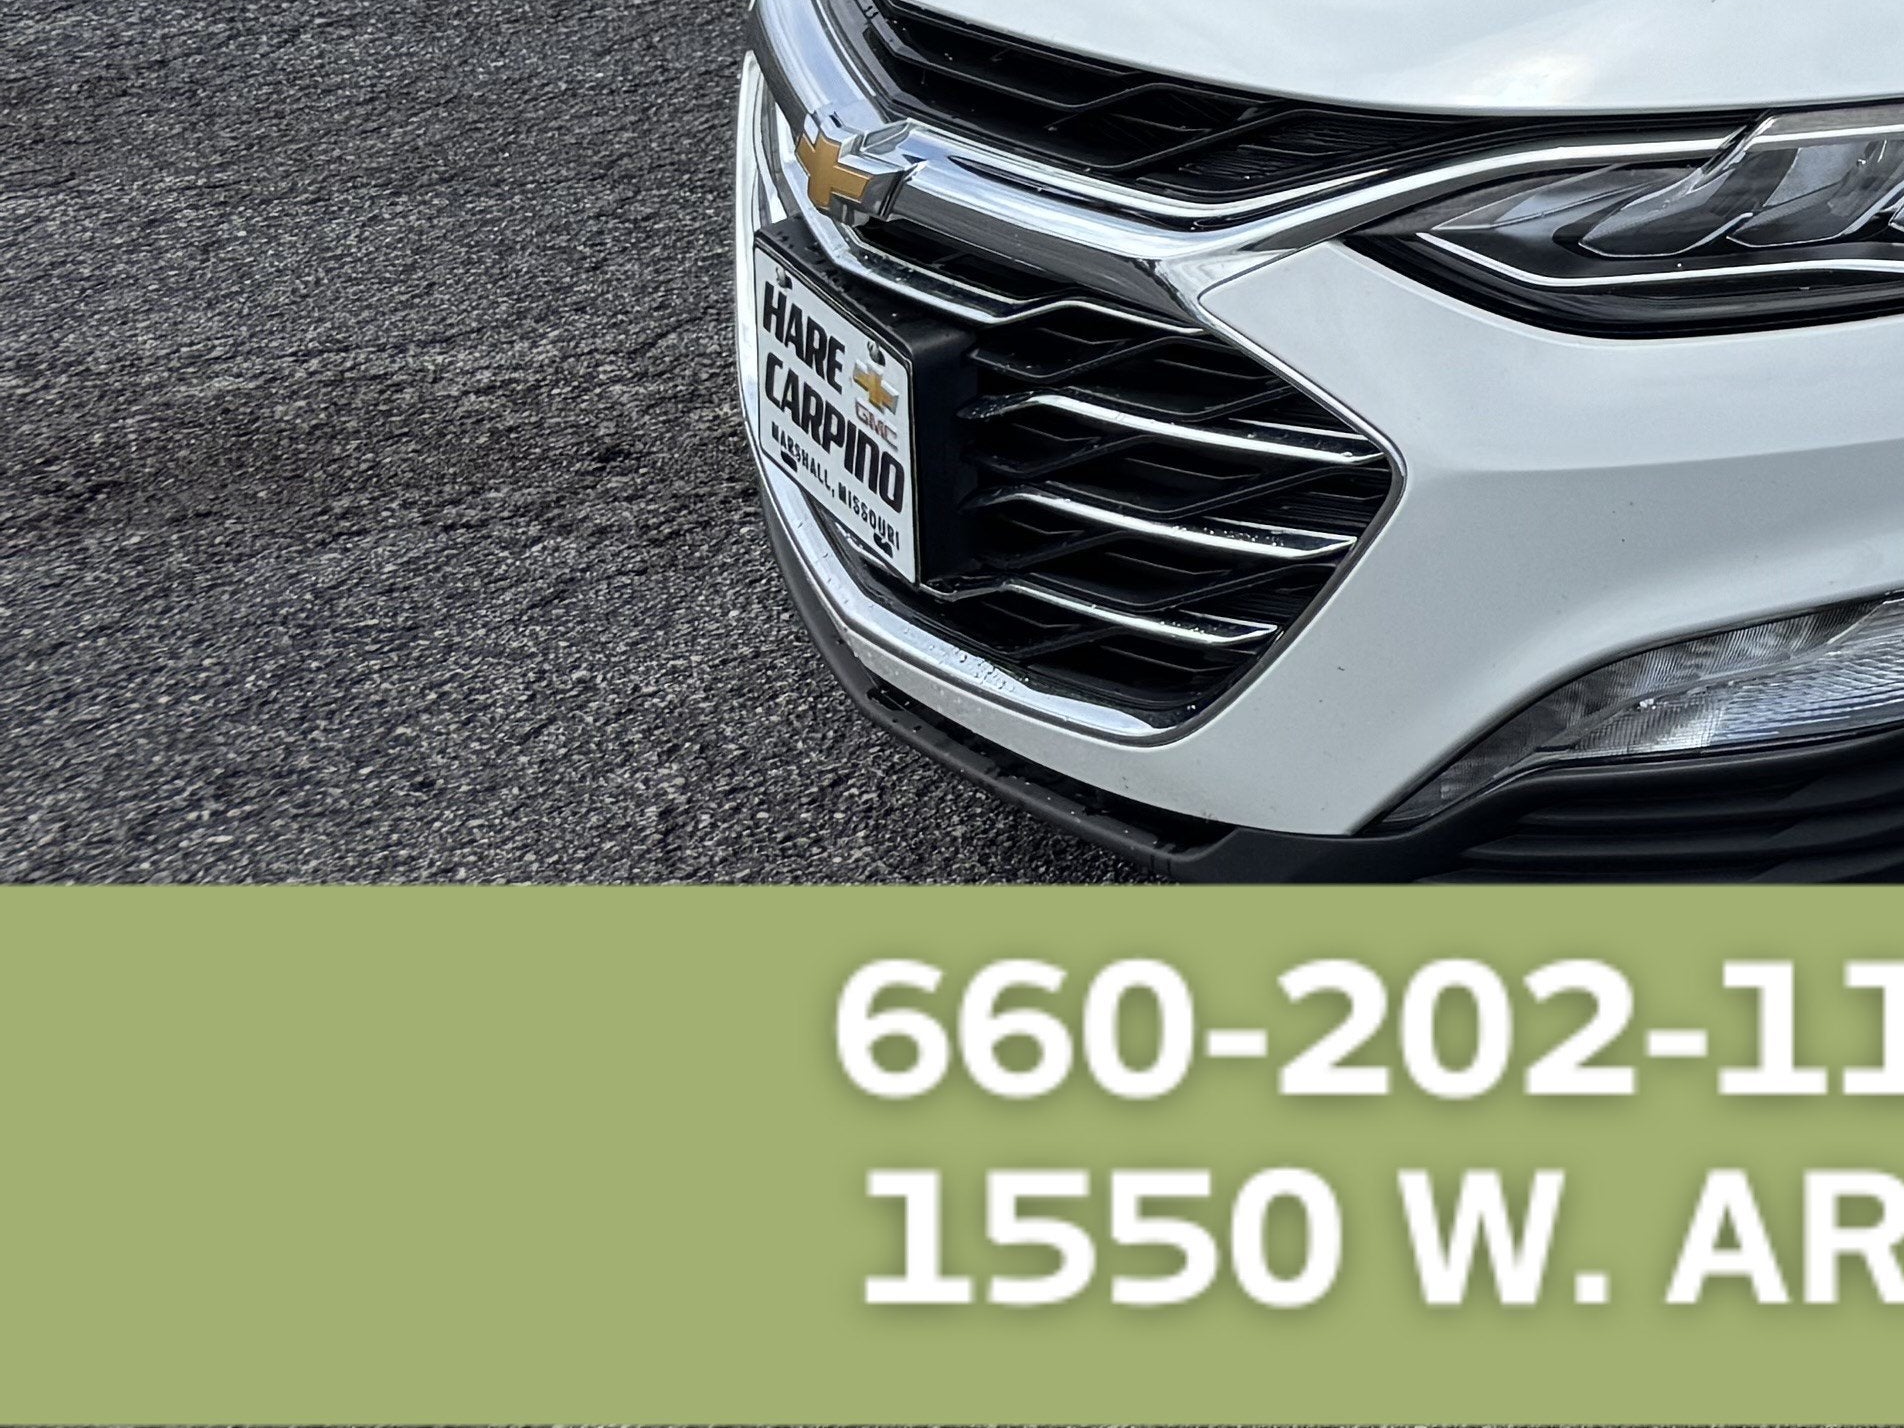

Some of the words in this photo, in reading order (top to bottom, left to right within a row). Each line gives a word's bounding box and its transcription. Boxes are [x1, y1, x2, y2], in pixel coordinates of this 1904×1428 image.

[762, 280, 846, 396] HARE
[764, 351, 906, 514] CARPINO
[771, 420, 837, 499] MARSHALL,
[838, 486, 901, 551] MISSOURI
[855, 400, 899, 453] GMC
